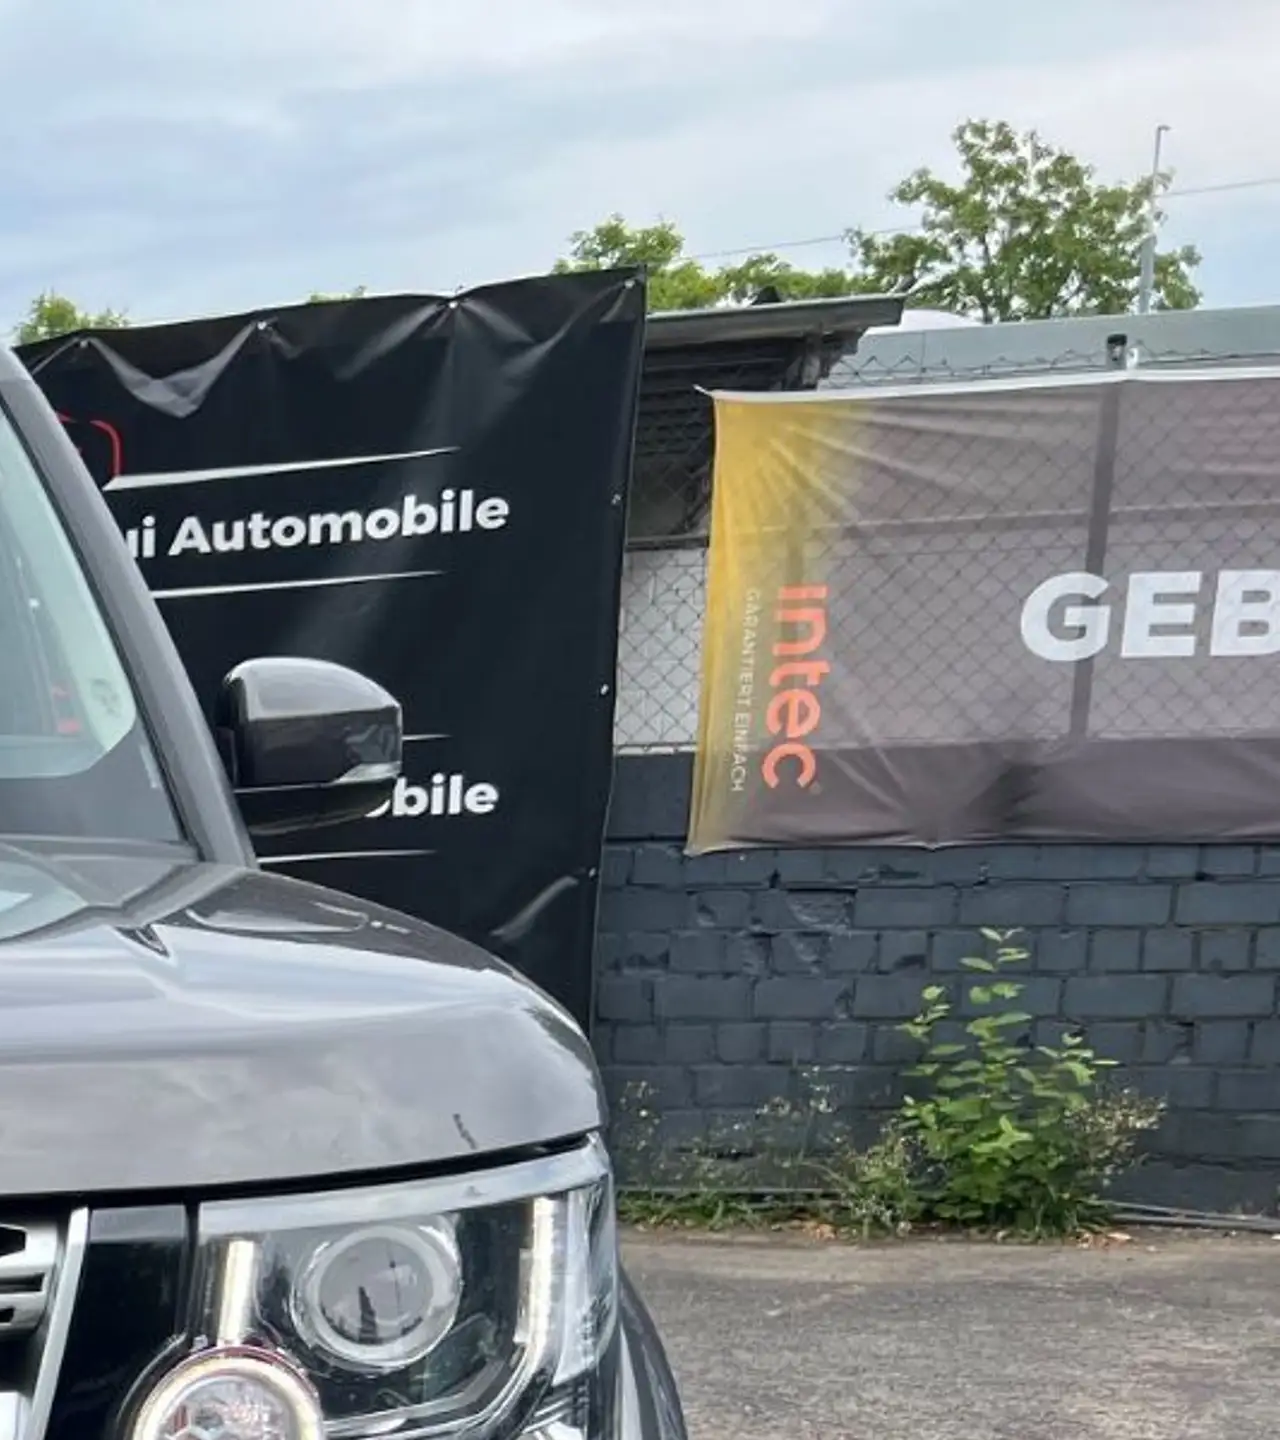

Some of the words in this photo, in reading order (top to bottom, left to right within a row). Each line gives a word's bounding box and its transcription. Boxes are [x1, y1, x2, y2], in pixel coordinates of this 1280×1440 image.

[166, 489, 509, 557] Automobile
[736, 588, 762, 706] GARANTIERT
[1020, 569, 1280, 661] GEB
[761, 584, 830, 789] intec
[364, 772, 500, 818] bile
[729, 714, 752, 793] EINFACH
